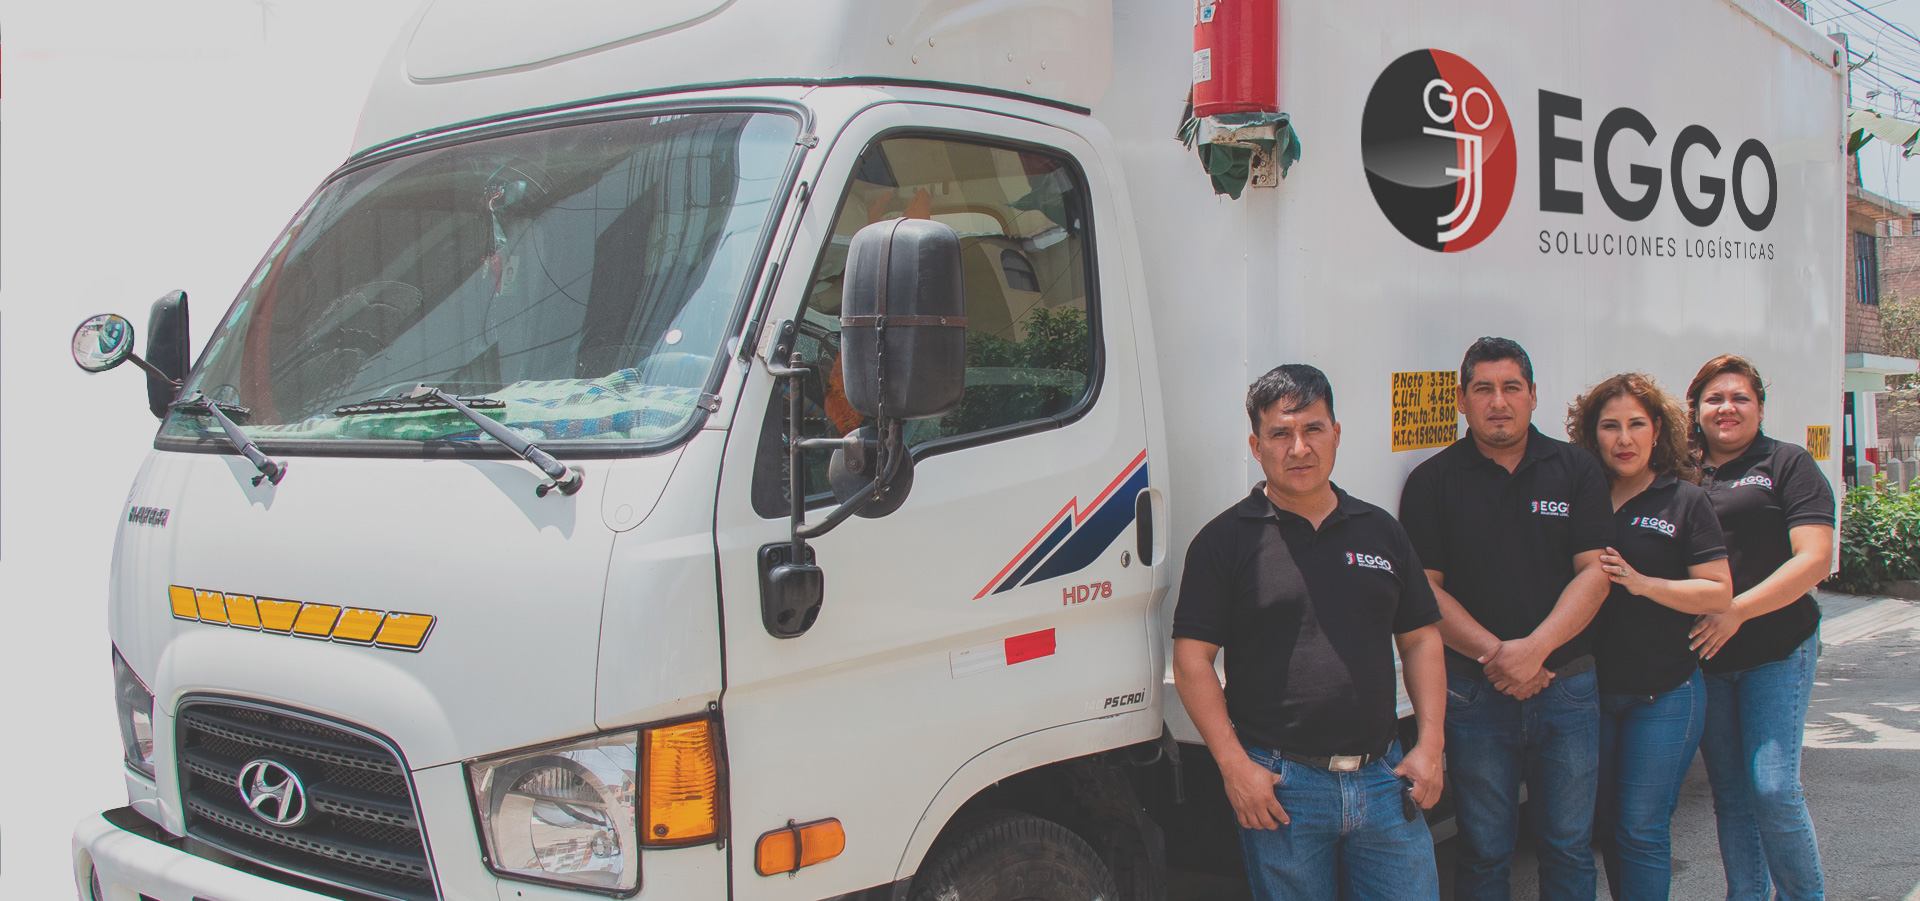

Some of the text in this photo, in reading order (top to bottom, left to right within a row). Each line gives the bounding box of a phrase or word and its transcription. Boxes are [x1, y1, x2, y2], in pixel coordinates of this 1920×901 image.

[1538, 88, 1778, 232] EGGO
[1539, 231, 1775, 261] SOLUCIONES LOGÍSTICAS
[1540, 500, 1569, 513] EGG
[1641, 516, 1676, 534] EGGO
[1356, 552, 1392, 571] EGGO
[1062, 581, 1113, 606] HD78
